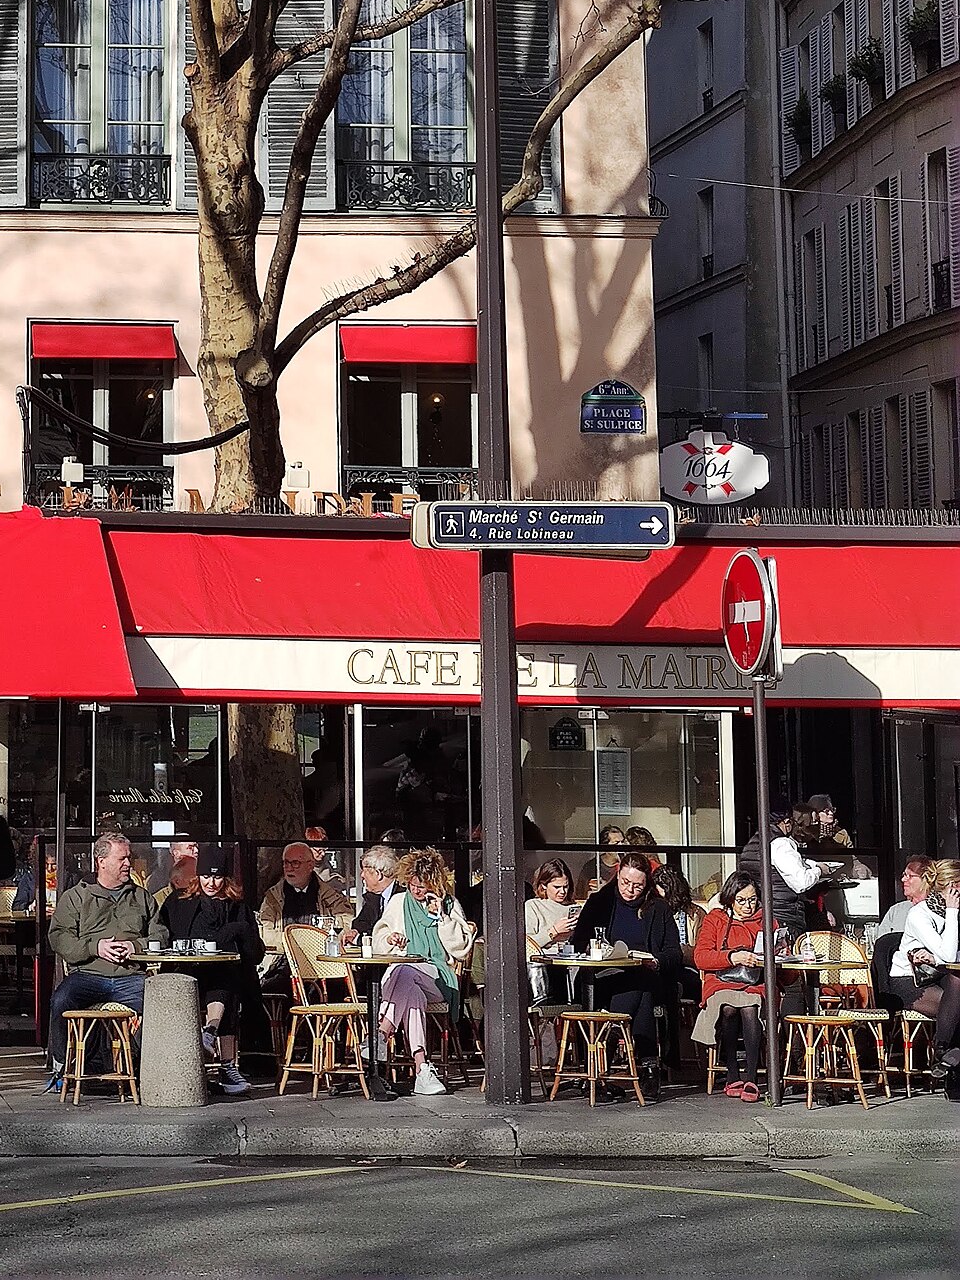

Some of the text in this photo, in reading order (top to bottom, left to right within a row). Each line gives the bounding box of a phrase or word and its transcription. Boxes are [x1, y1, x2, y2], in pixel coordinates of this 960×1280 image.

[593, 408, 631, 418] PLACE
[596, 419, 642, 430] SULPICE
[683, 456, 732, 479] 1664
[468, 509, 604, 525] Marché St Germain
[488, 527, 513, 539] Rue
[517, 528, 574, 540] Lobineau
[347, 648, 778, 691] CAFE E LA MAIR
